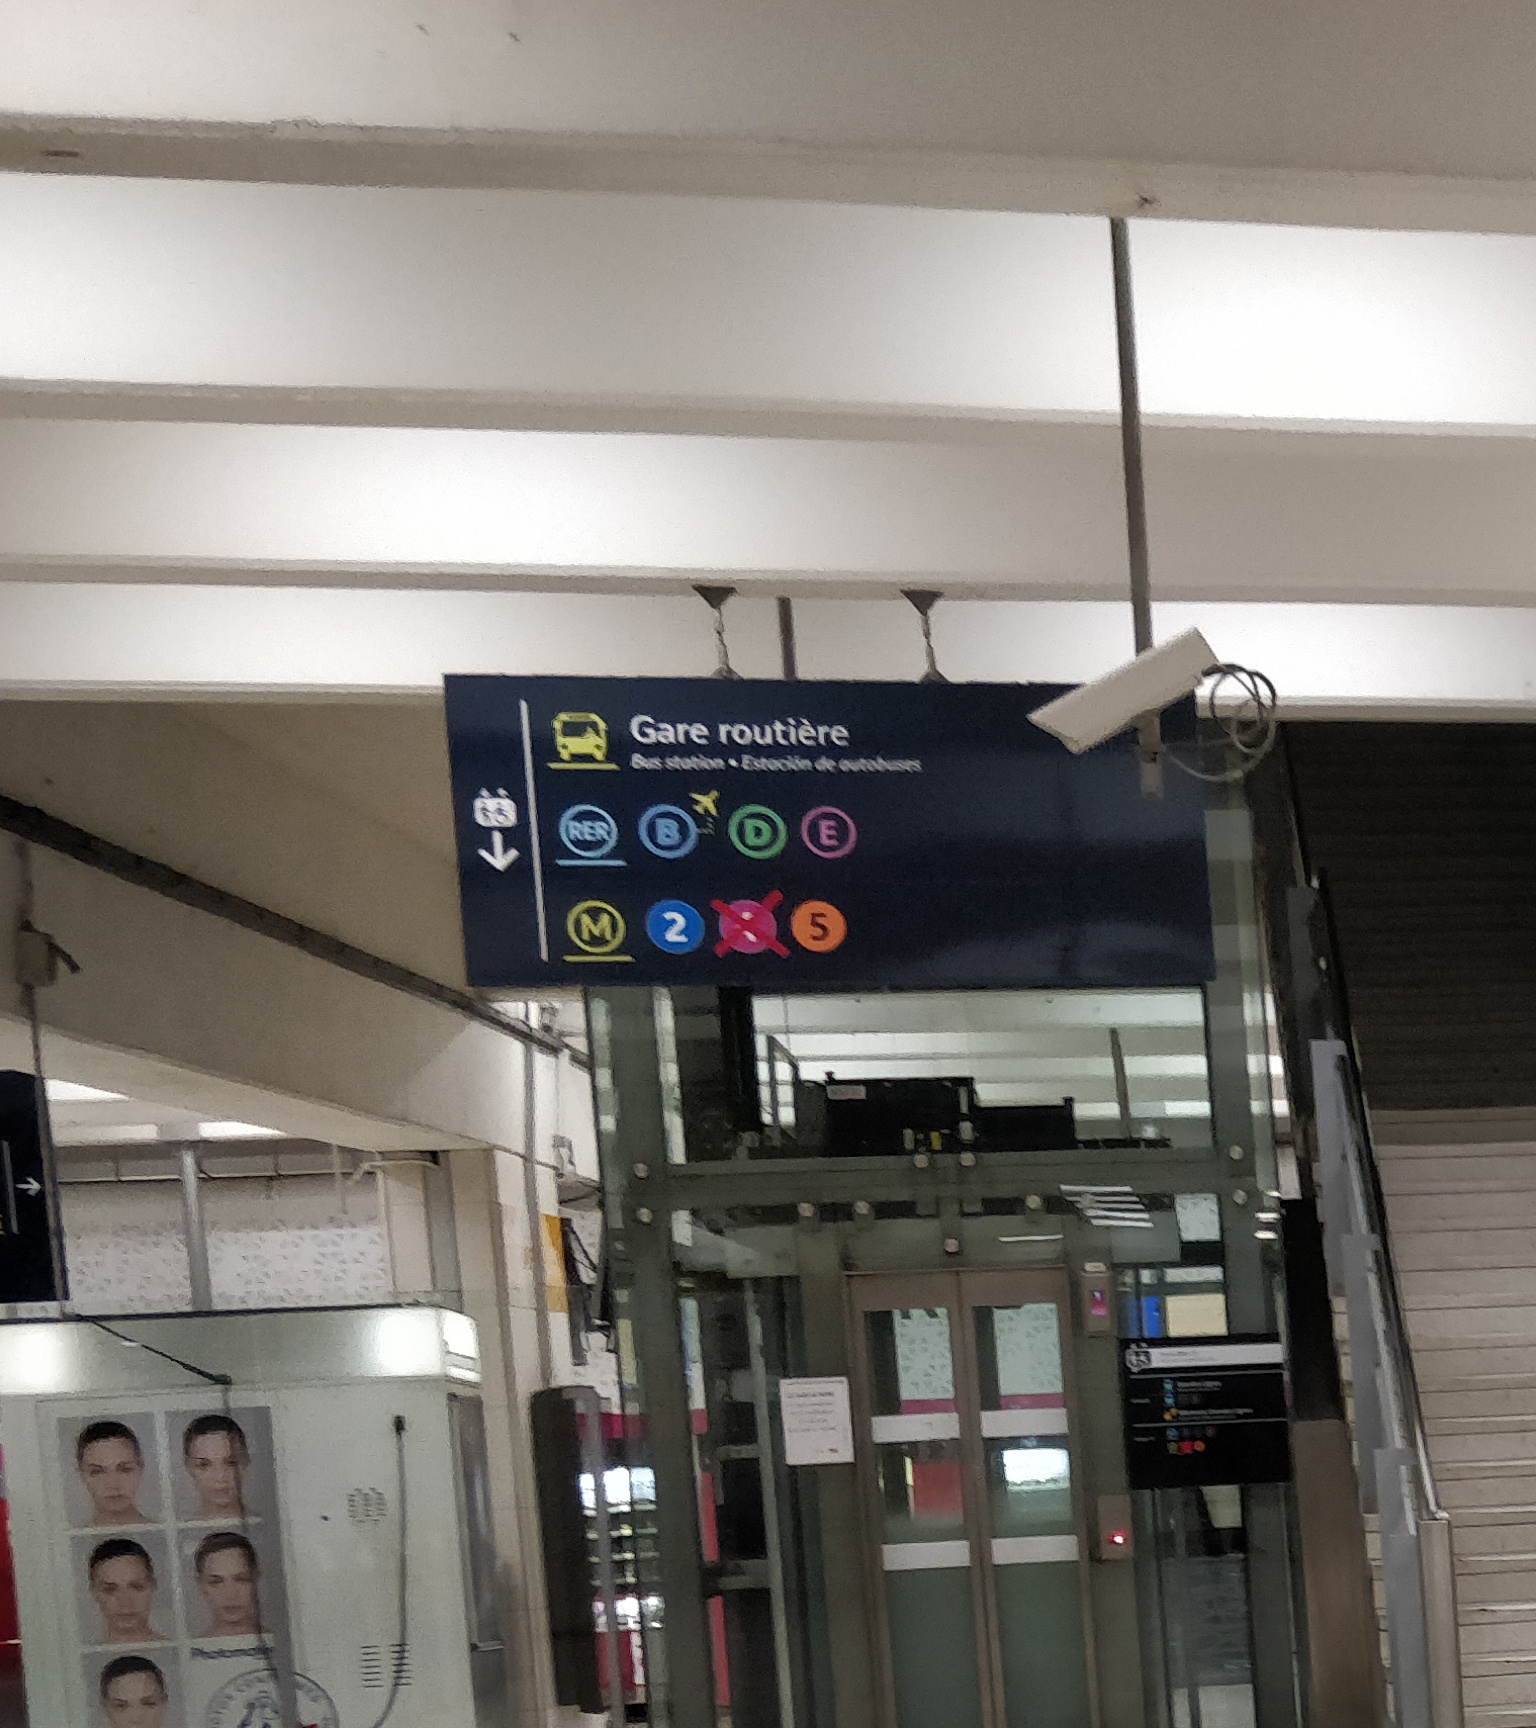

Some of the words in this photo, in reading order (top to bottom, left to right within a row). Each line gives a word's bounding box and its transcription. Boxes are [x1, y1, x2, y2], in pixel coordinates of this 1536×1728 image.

[629, 714, 709, 745] Gare
[718, 717, 850, 746] routière
[567, 820, 612, 843] RER
[655, 817, 681, 847] B
[743, 818, 772, 847] D
[818, 818, 840, 847] E
[579, 913, 613, 942] M
[662, 911, 689, 943] 2
[809, 912, 830, 942] 5
